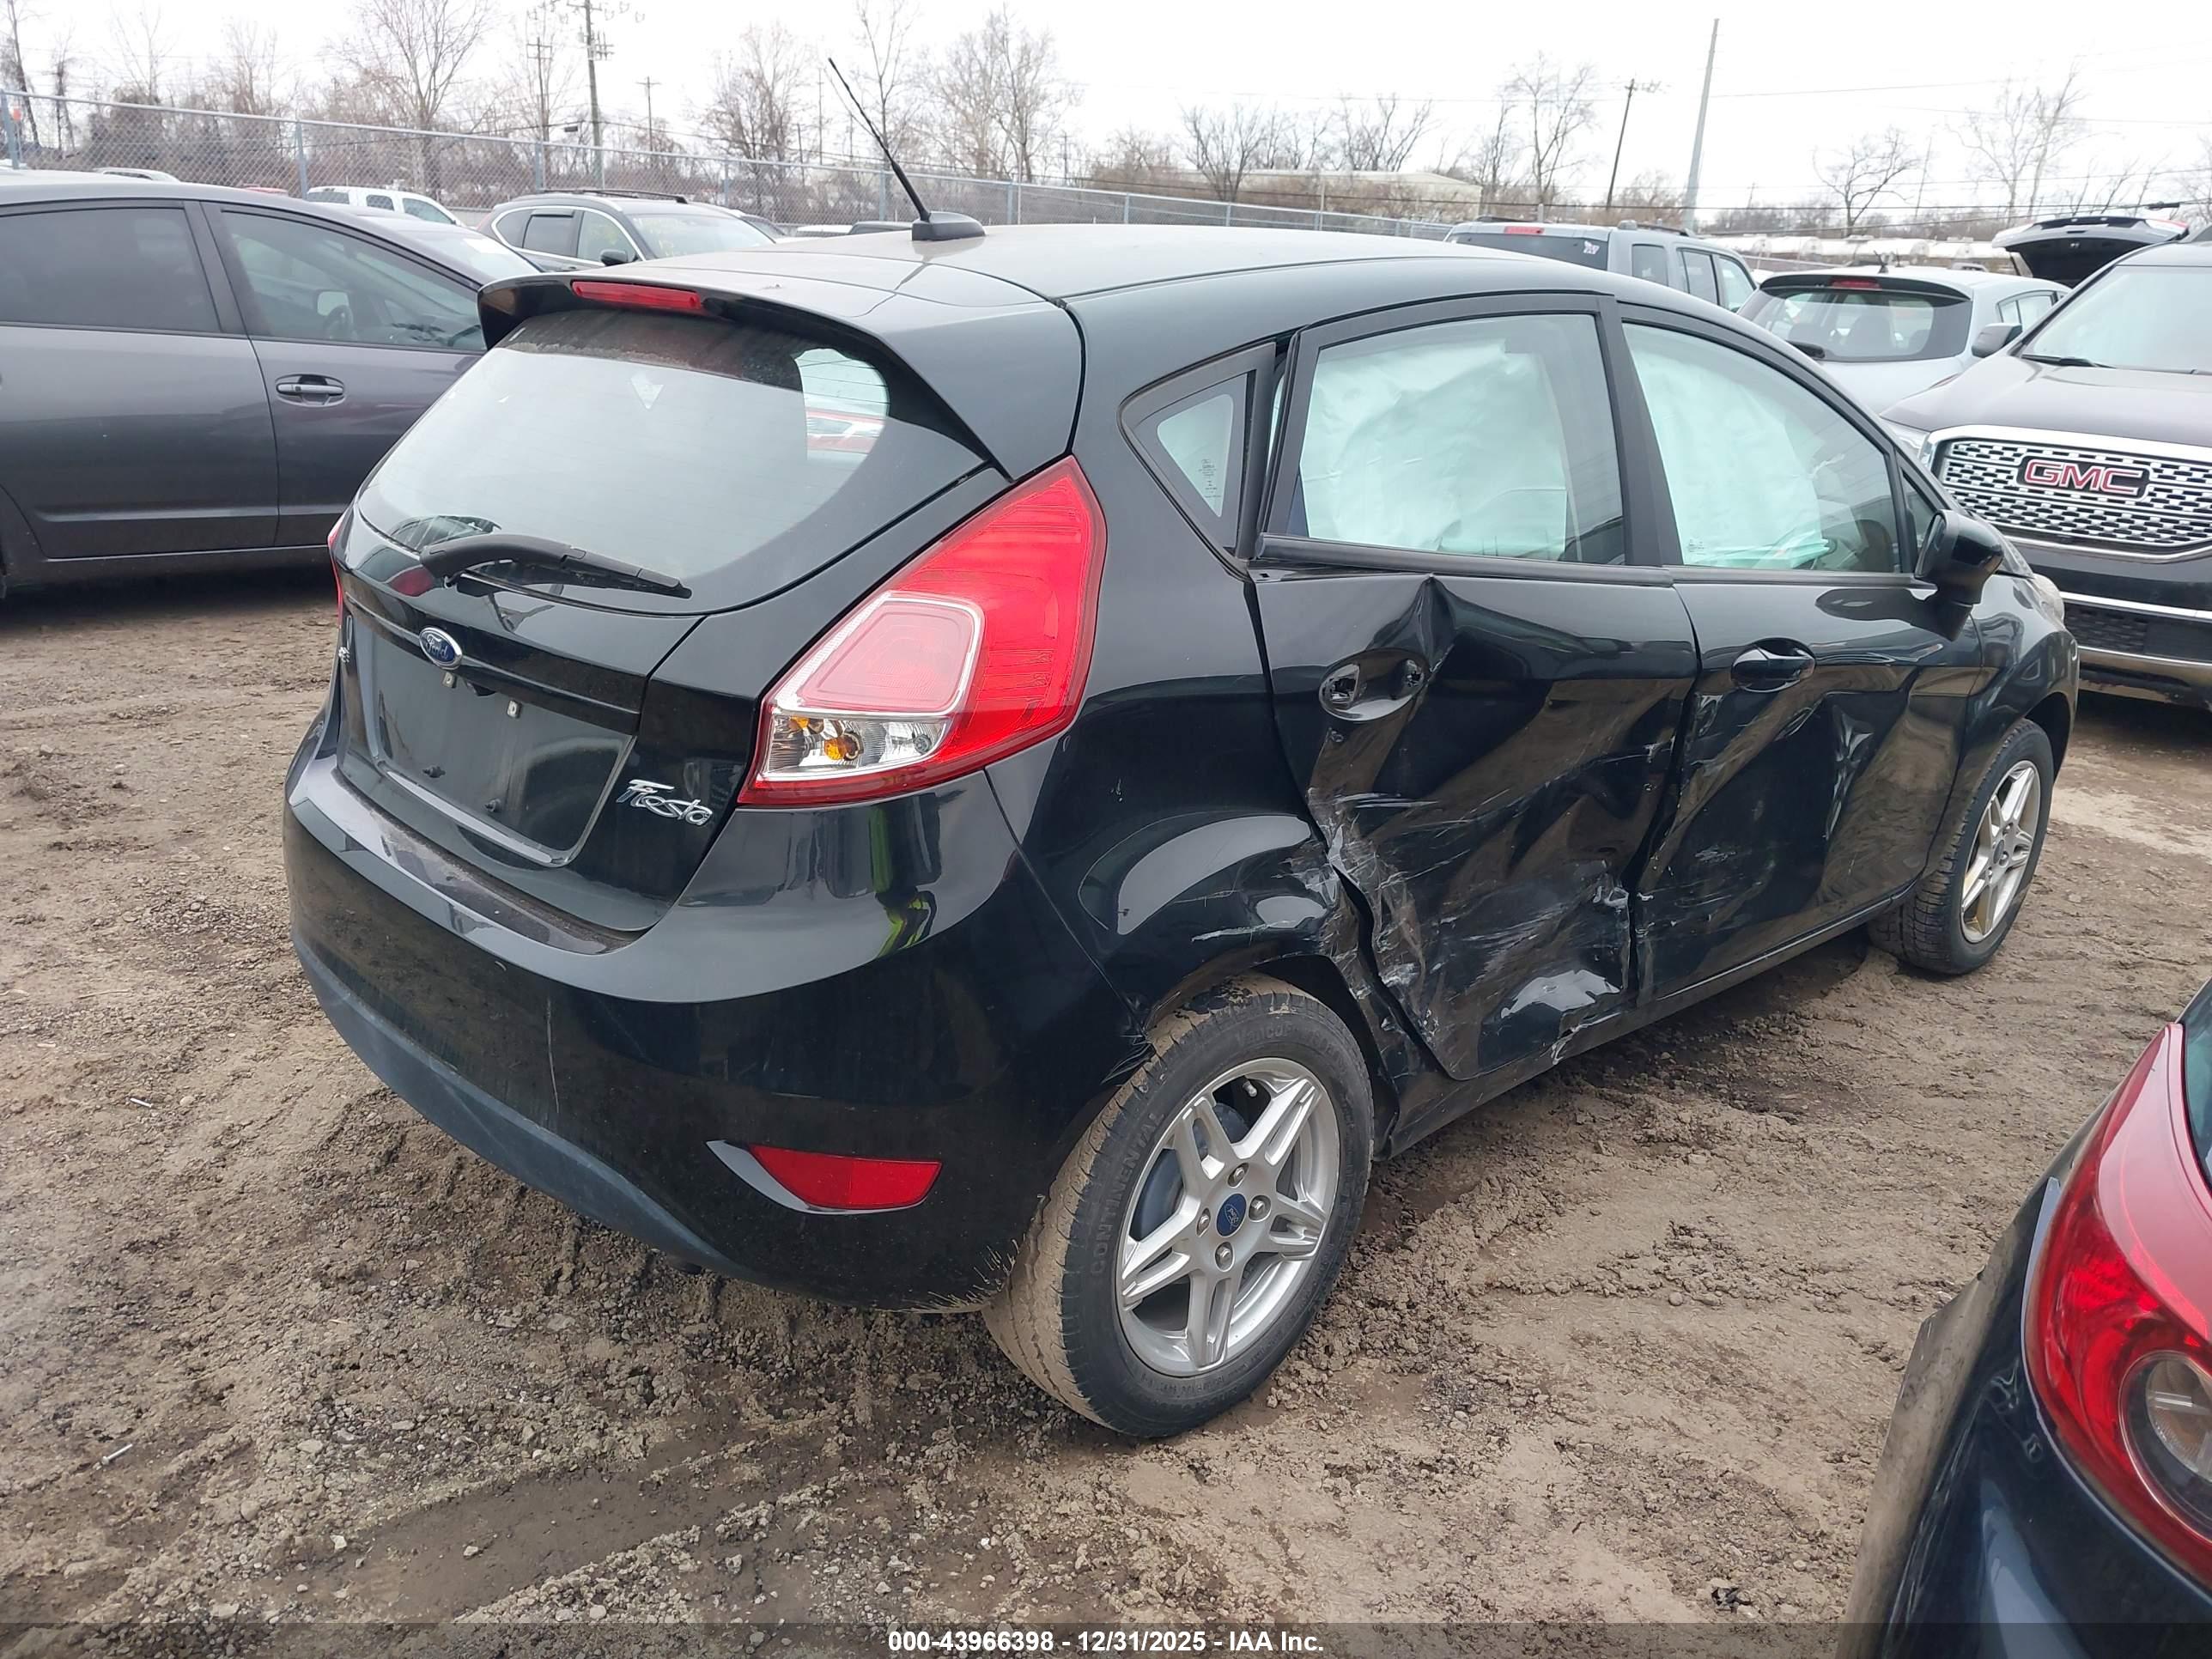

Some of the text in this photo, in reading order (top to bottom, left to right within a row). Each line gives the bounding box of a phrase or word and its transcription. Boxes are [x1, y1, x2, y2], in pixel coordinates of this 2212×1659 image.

[2024, 459, 2144, 495] GMC
[616, 779, 714, 826] Fiesta
[1091, 1113, 1164, 1274] CONTINENTAL
